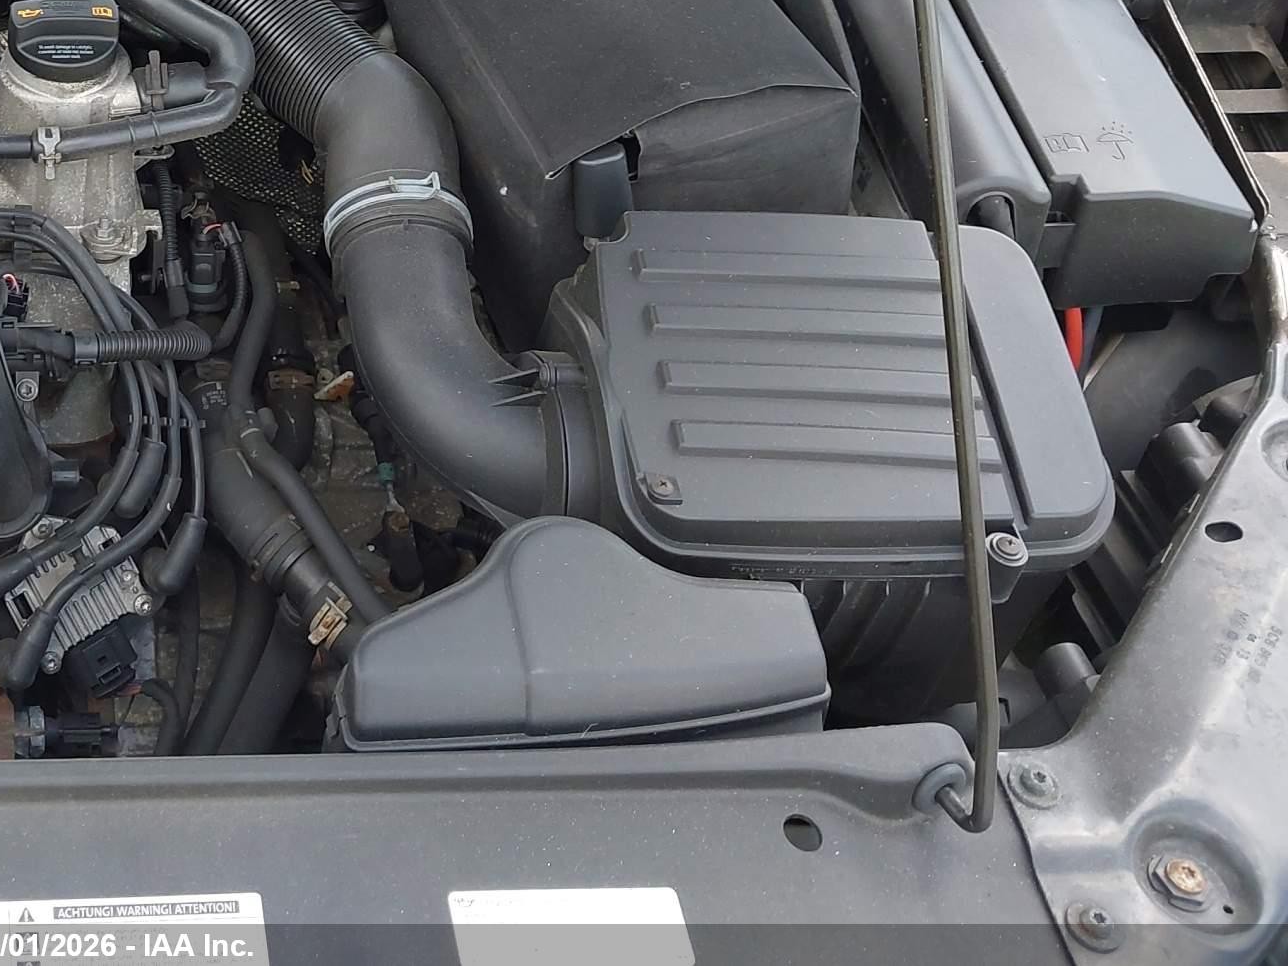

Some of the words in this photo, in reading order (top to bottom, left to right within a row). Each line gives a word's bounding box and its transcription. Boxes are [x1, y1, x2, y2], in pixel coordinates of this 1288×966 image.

[57, 905, 114, 920] ACHTUNG!
[116, 903, 173, 917] WARNING!
[174, 901, 236, 915] ATTENTION!
